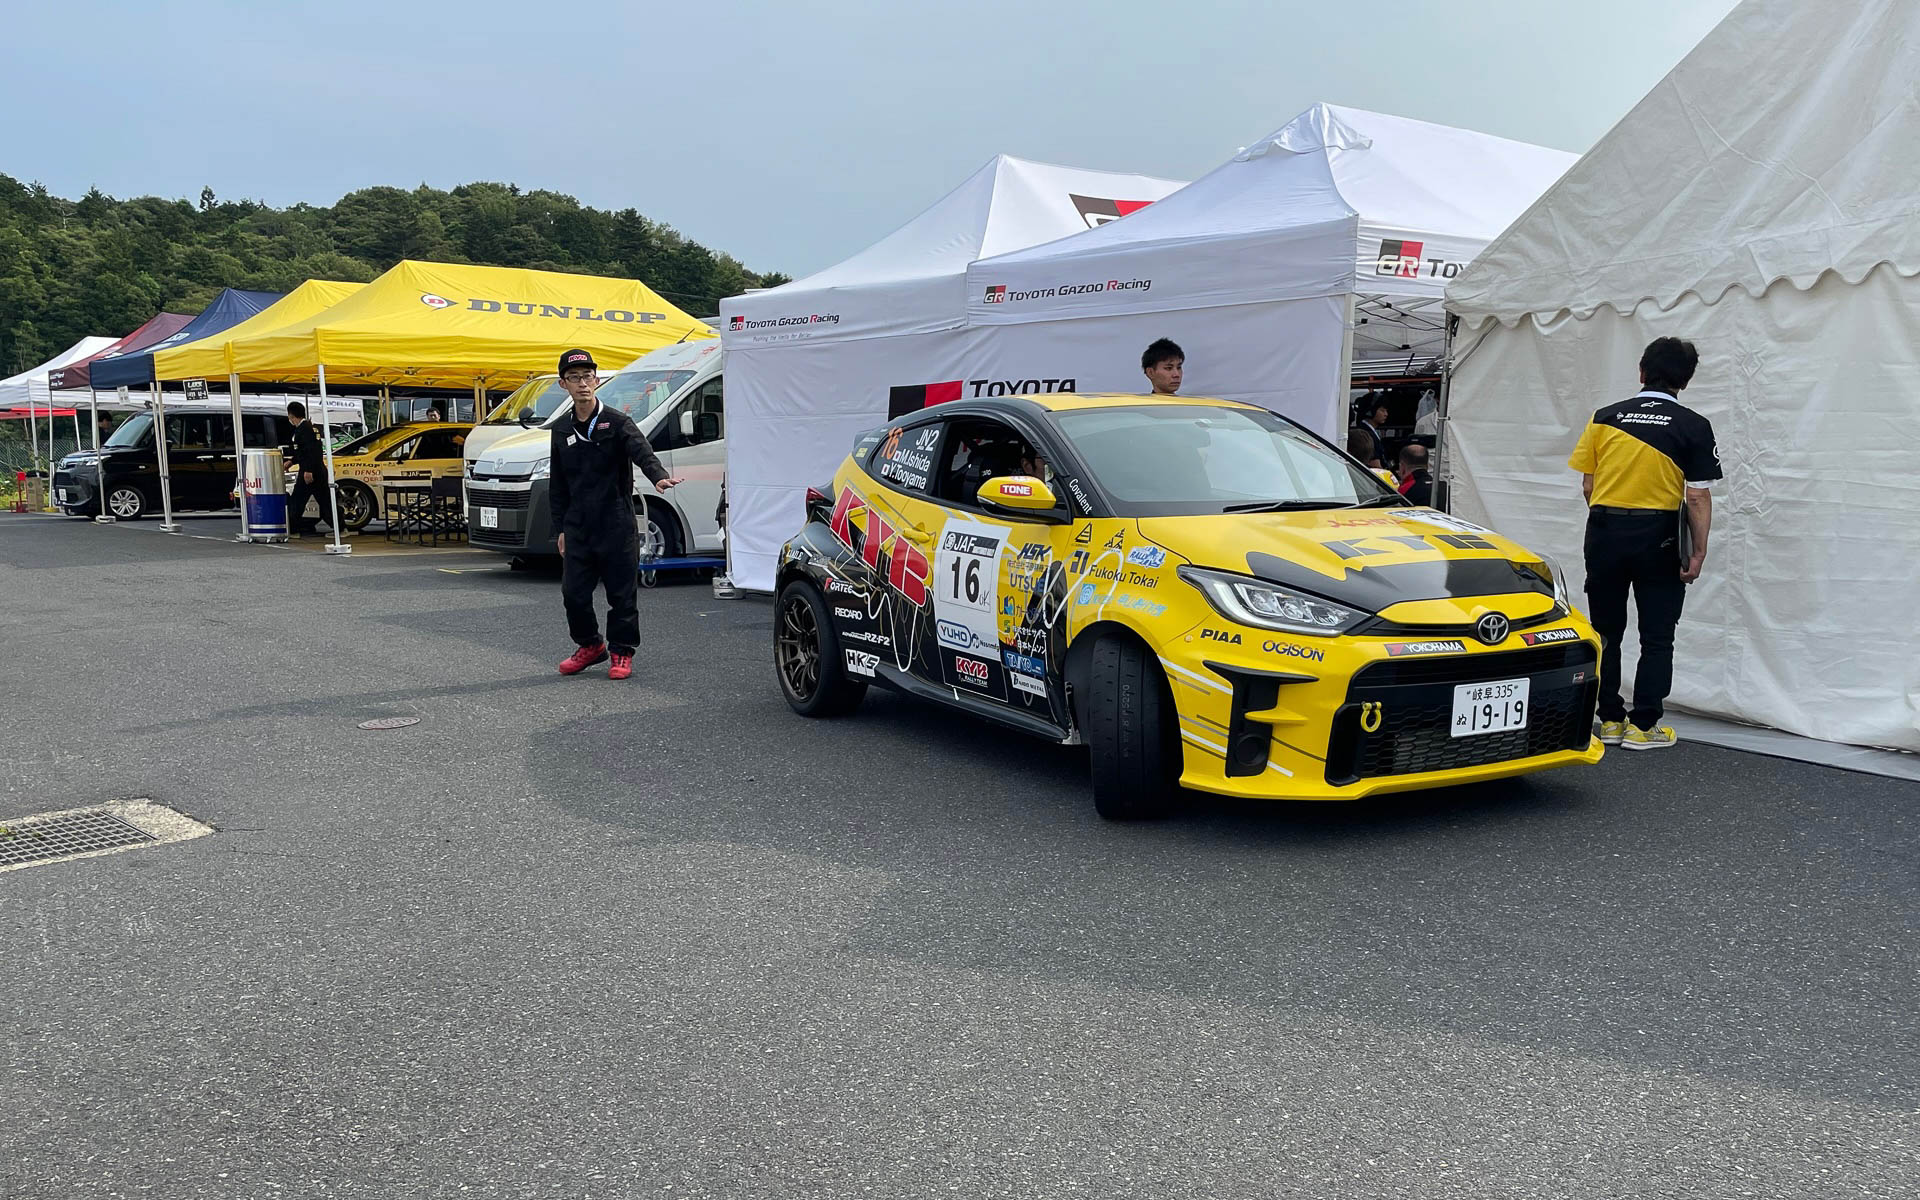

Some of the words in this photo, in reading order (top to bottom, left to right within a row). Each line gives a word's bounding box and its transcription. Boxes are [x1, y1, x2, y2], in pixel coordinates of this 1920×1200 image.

[1377, 254, 1419, 276] GR
[1427, 258, 1464, 278] TO
[1009, 288, 1055, 302] TOYOTA
[1058, 283, 1104, 296] GAZOO
[1106, 279, 1151, 291] Racing
[467, 298, 666, 324] DUNLOP
[746, 320, 776, 329] TOYOTA
[778, 317, 809, 326] GAZOO
[810, 314, 840, 324] Racing
[969, 378, 1076, 398] TOYOTA
[1620, 418, 1669, 426] MOTORSPORT
[1625, 413, 1673, 421] DUNLOP
[915, 429, 940, 451] JN2
[900, 448, 931, 472] M.Ishida
[888, 462, 927, 489] Y.Tooyama
[1002, 485, 1031, 495] TONE
[1069, 478, 1094, 515] Covalent
[830, 485, 929, 608] KYB
[953, 535, 977, 553] JAF
[824, 577, 854, 593] FORTEC
[951, 556, 980, 603] 16
[1088, 564, 1127, 582] Fukoku
[1128, 572, 1160, 588] Tokai
[834, 607, 863, 620] RECARO
[940, 625, 967, 642] YUHO
[1200, 628, 1242, 645] PIAA
[1535, 630, 1578, 643] YOKOHAMA
[1262, 639, 1325, 662] OGISON
[1406, 640, 1464, 653] YOKOHAMA
[846, 650, 880, 670] HKS
[956, 656, 988, 679] KYB
[1472, 687, 1493, 701] 岐阜
[1494, 684, 1513, 698] 335
[1456, 713, 1467, 726] ぬ
[1471, 699, 1524, 731] 19-19
